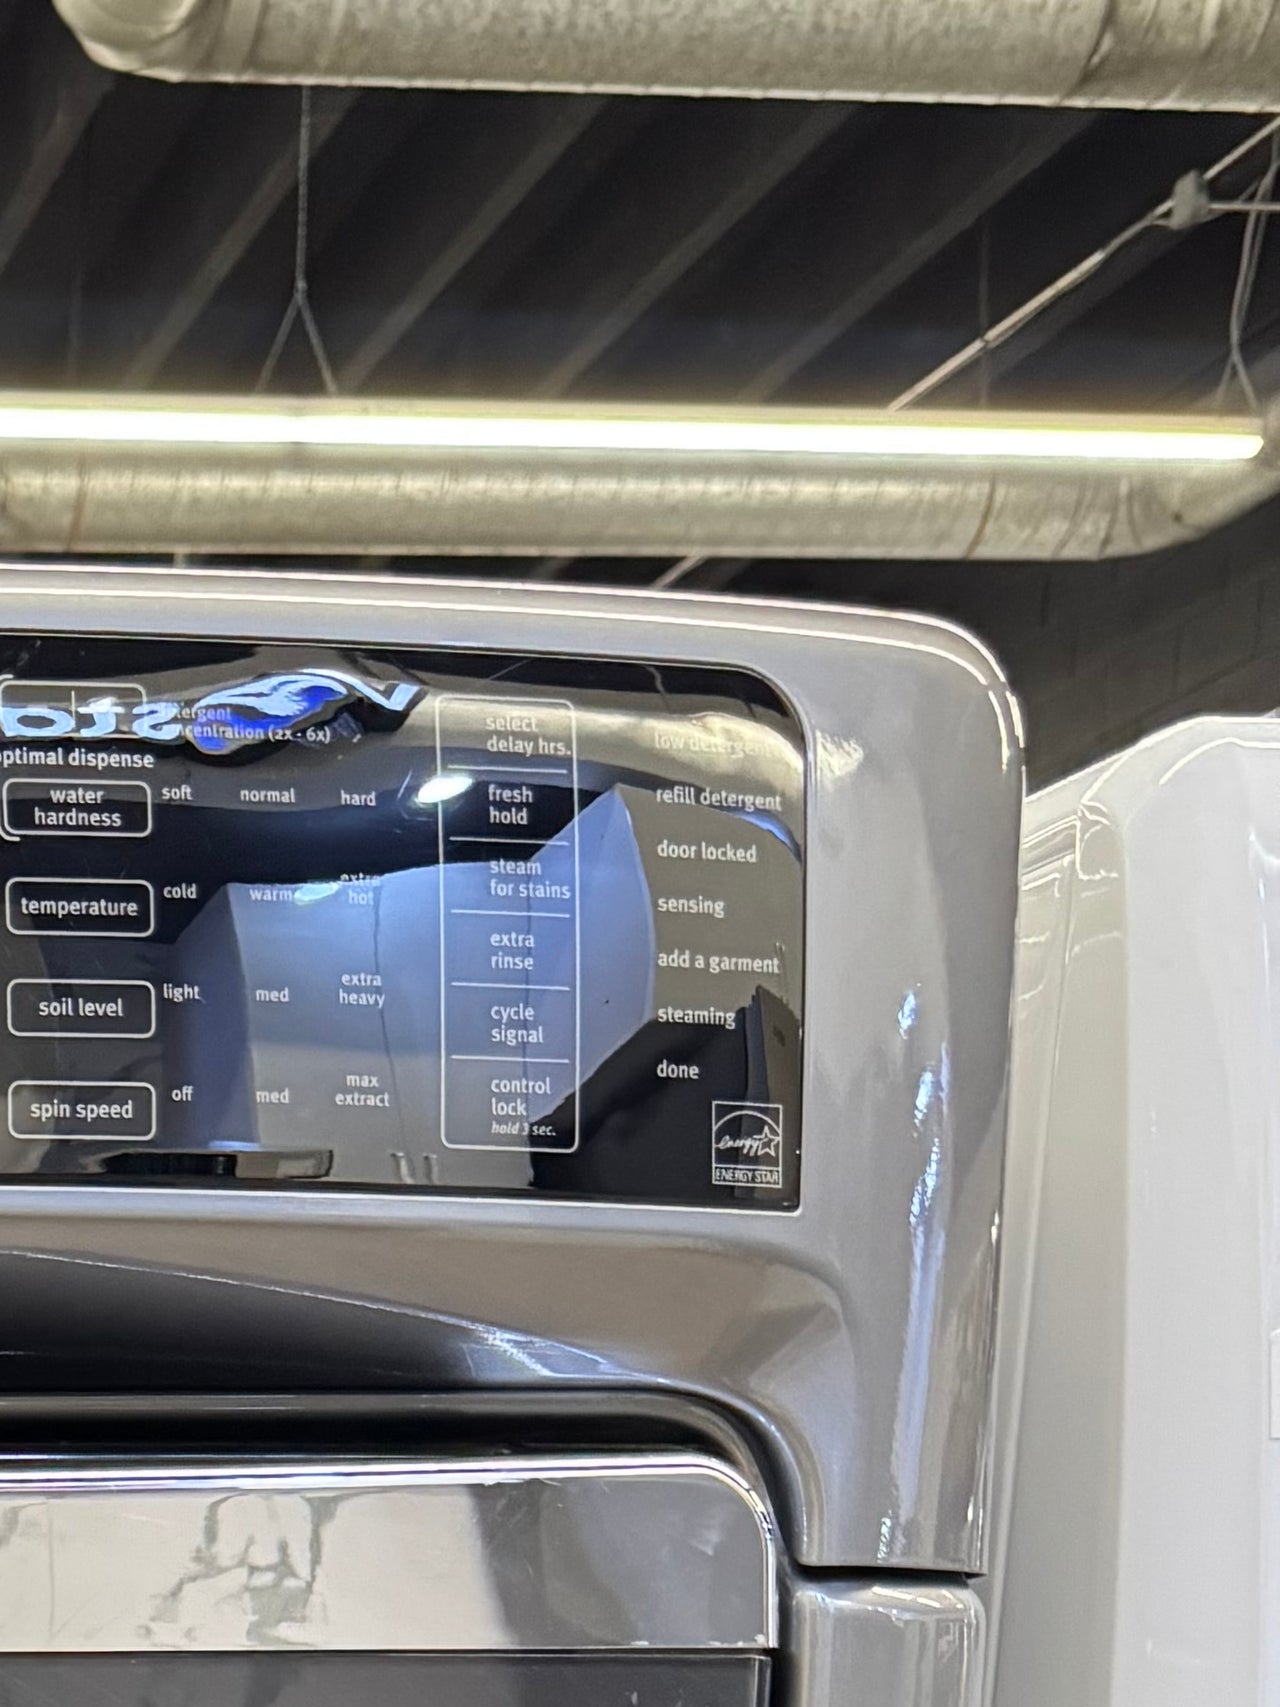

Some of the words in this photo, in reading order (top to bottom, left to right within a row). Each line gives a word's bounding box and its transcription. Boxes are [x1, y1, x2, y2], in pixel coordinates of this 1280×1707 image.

[485, 715, 539, 734] select
[305, 726, 332, 745] 6x)
[653, 731, 685, 750] low
[486, 736, 534, 758] delay
[537, 737, 573, 757] hrs.
[67, 748, 155, 771] dispense
[49, 786, 105, 805] water
[161, 785, 193, 802] soft
[239, 788, 296, 805] normal
[340, 790, 377, 807] hard
[487, 784, 534, 805] fresh
[655, 784, 697, 806] refill
[699, 786, 783, 813] detergent
[33, 806, 122, 828] hardness
[488, 805, 529, 826] hold
[656, 840, 697, 862] door
[700, 843, 758, 865] locked
[489, 858, 542, 877] steam
[163, 883, 198, 900] cold
[248, 887, 294, 902] warm
[348, 888, 374, 905] hot
[489, 879, 515, 898] for
[518, 881, 572, 900] stains
[20, 896, 139, 922] temperature
[656, 896, 726, 919] sensing
[489, 931, 536, 949] extra
[490, 951, 535, 971] rinse
[657, 949, 693, 969] add
[694, 955, 706, 970] a
[708, 955, 781, 977] garment
[341, 971, 382, 988] extra
[162, 983, 201, 1004] light
[255, 986, 291, 1003] med
[338, 989, 386, 1010] heavy
[38, 997, 75, 1018] soil
[77, 997, 124, 1019] level
[489, 1003, 536, 1025] cycle
[656, 1006, 737, 1031] steaming
[490, 1024, 544, 1046] signal
[345, 1073, 380, 1089] max
[656, 1060, 700, 1081] done
[170, 1085, 195, 1103] off
[255, 1087, 291, 1104] med
[490, 1076, 552, 1096] control
[29, 1100, 72, 1122] spin
[74, 1099, 134, 1122] speed
[334, 1091, 391, 1109] extract
[491, 1097, 528, 1117] lock
[490, 1120, 520, 1136] hold
[531, 1123, 557, 1138] sec.
[714, 1168, 755, 1183] ENERGY
[754, 1170, 780, 1184] STAR
